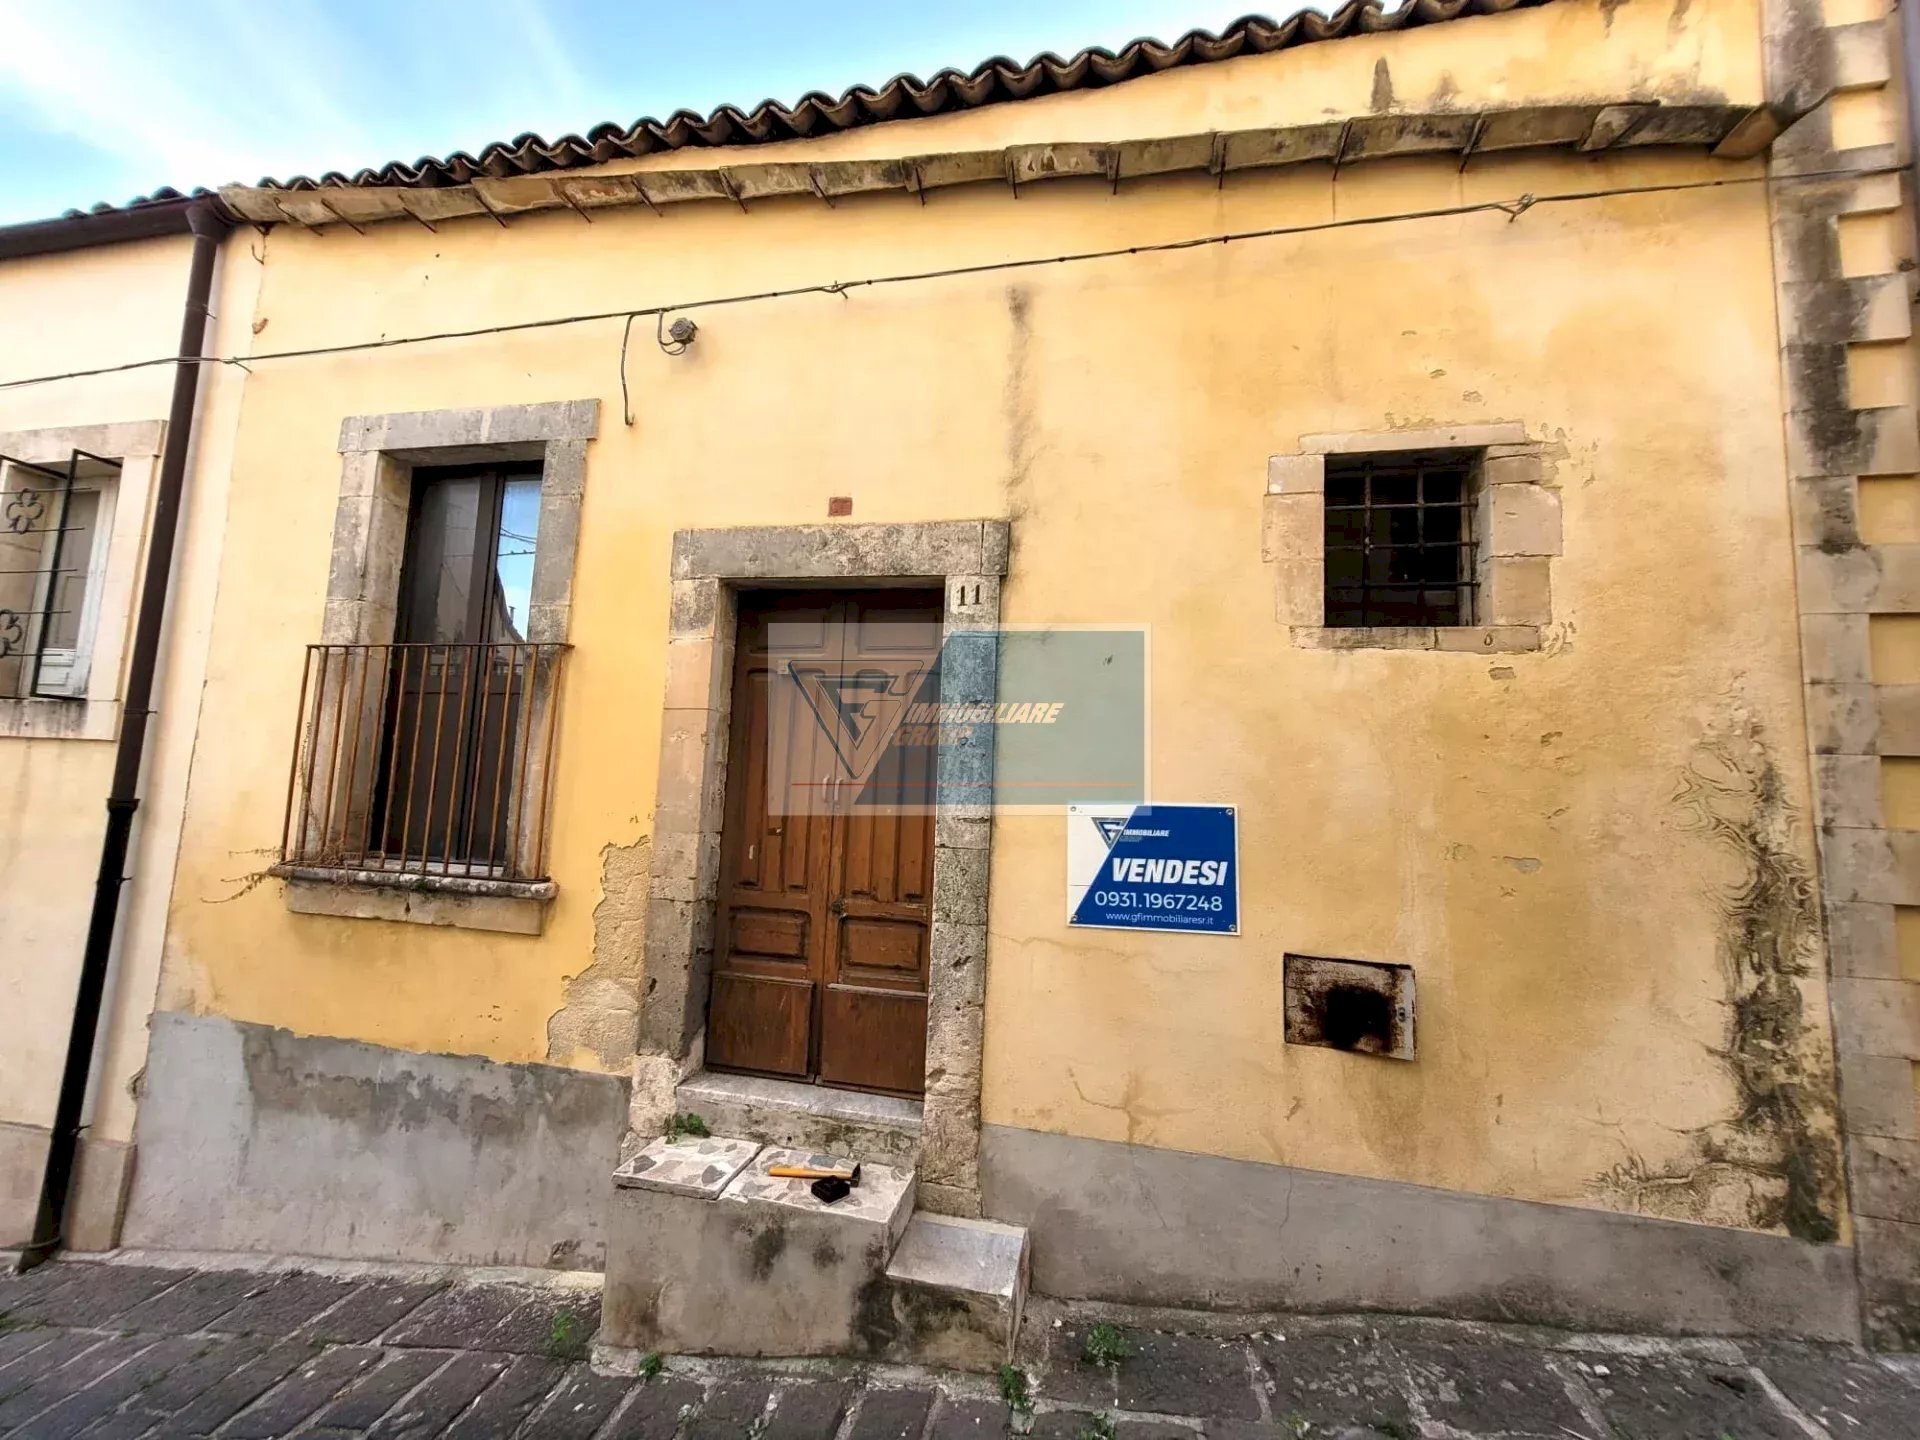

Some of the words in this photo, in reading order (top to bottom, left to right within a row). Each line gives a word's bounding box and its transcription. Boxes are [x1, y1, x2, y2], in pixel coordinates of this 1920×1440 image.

[957, 584, 982, 606] 11
[1122, 829, 1170, 838] IMMOBILIARE
[1112, 857, 1228, 886] VENDESI
[1094, 891, 1223, 911] 0931.1967248
[1105, 912, 1214, 925] www.gfimmobiliaresr.it
